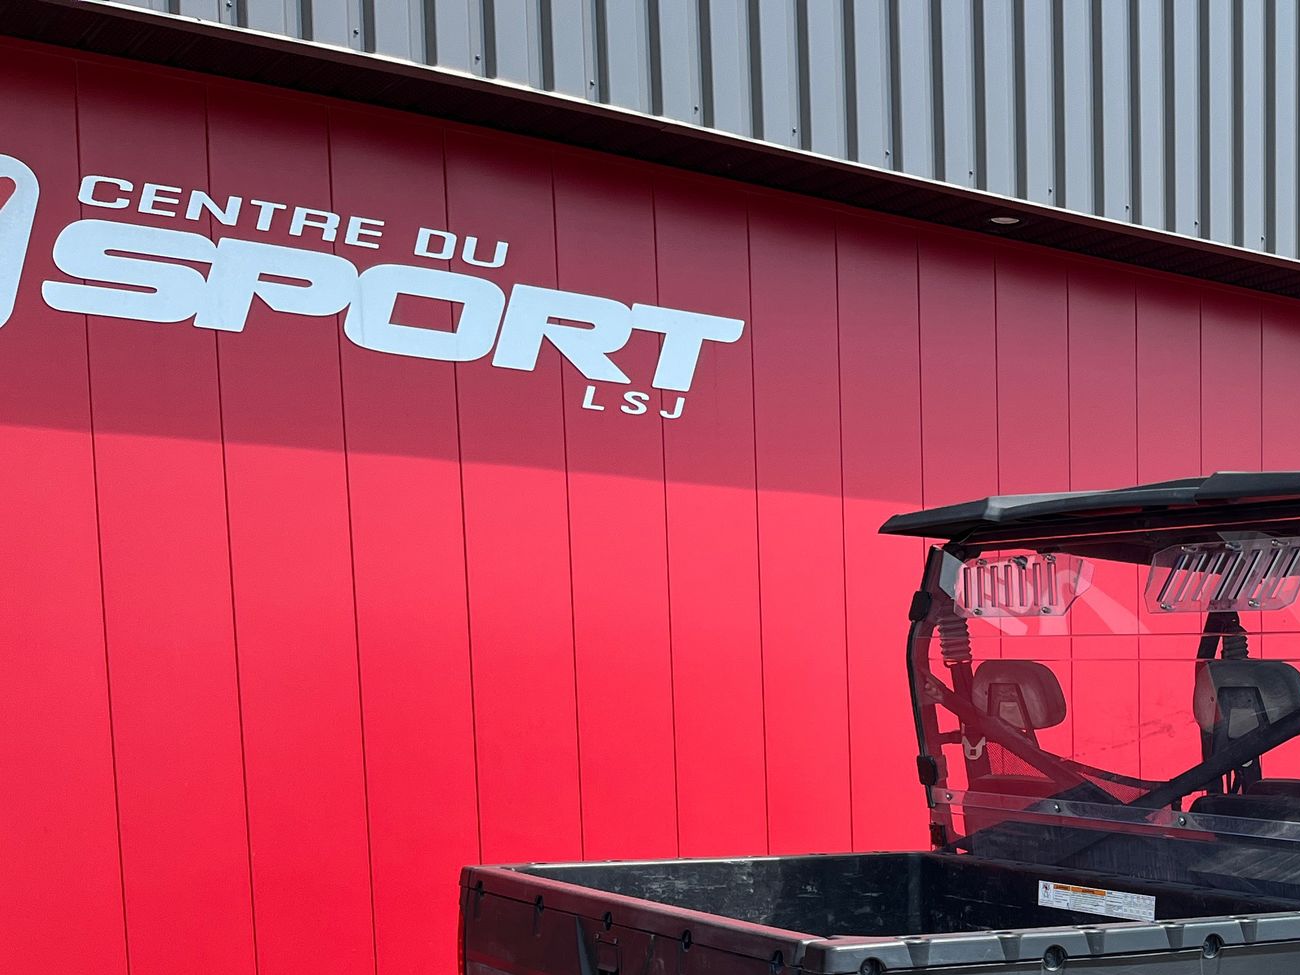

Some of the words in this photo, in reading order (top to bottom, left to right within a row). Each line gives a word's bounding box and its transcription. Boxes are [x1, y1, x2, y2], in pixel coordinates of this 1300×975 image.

[78, 175, 385, 249] CENTRE
[414, 227, 508, 268] DU
[41, 219, 745, 392] SPORT
